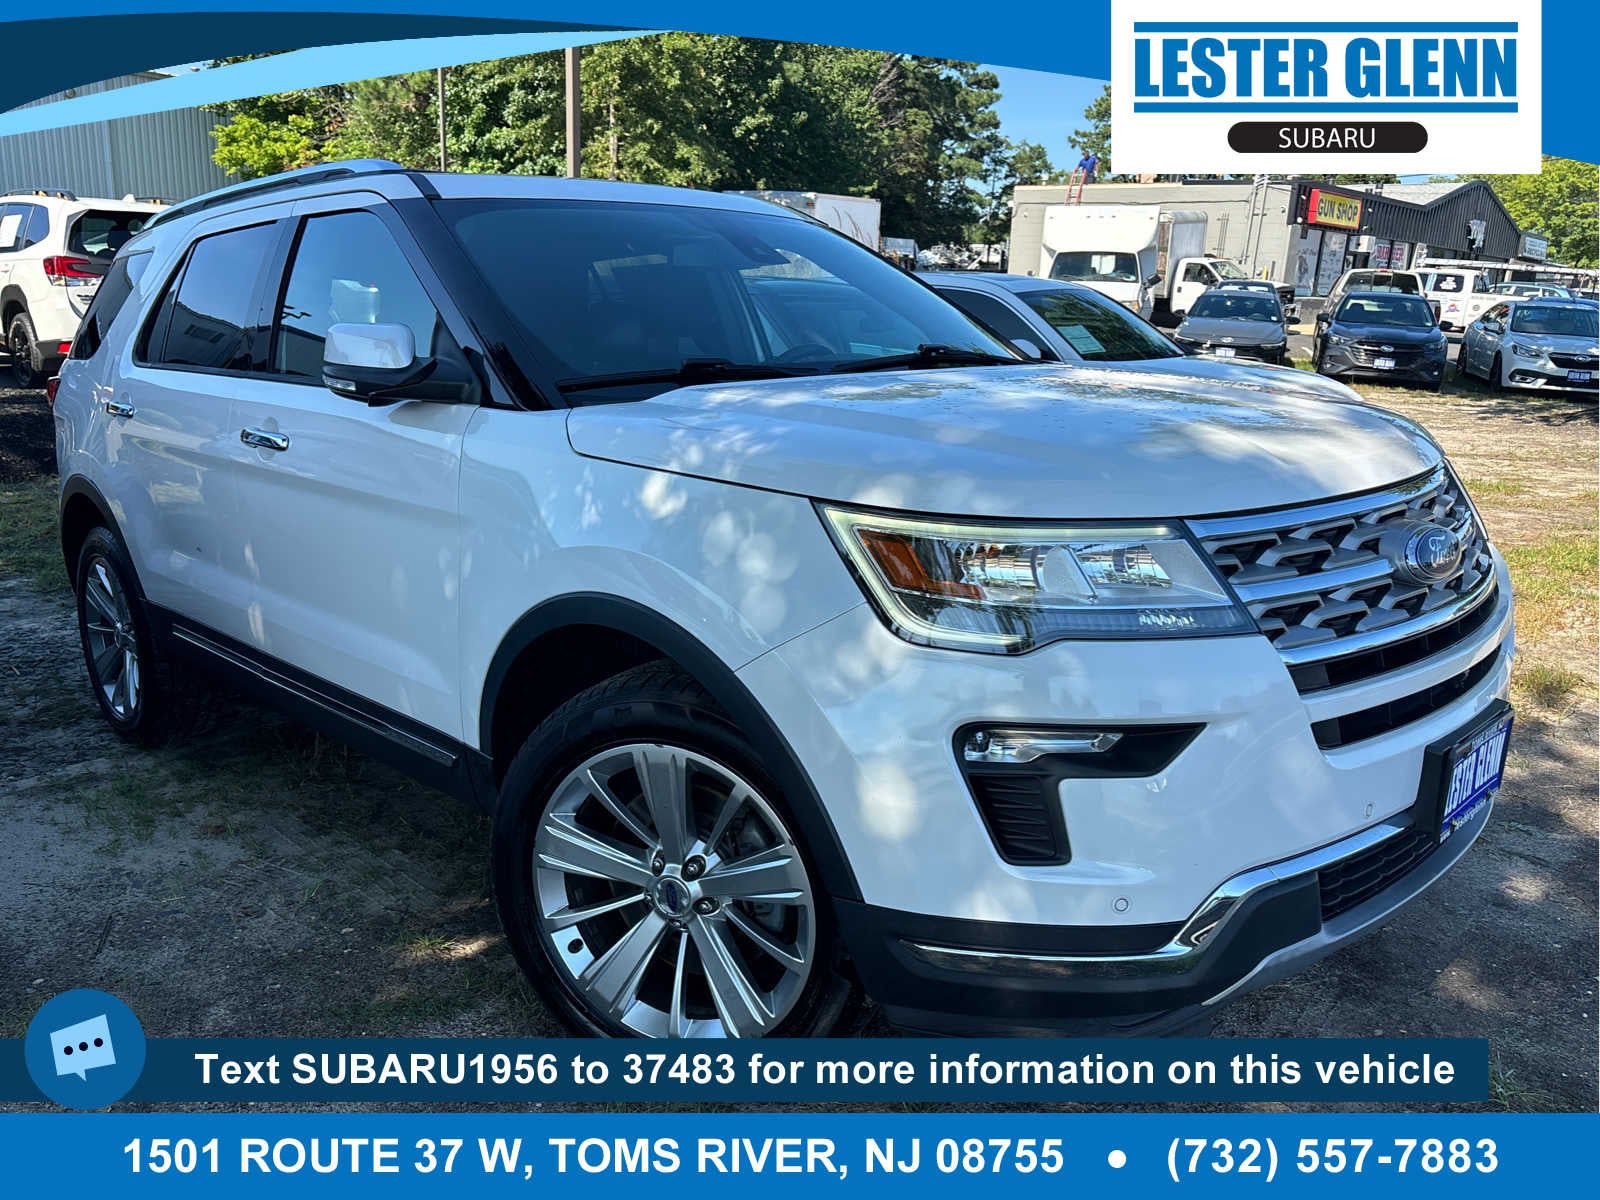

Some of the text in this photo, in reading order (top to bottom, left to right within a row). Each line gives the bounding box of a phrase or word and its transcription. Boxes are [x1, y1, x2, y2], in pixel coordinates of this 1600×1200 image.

[1318, 198, 1359, 221] GUN SHOP
[1474, 731, 1506, 790] GLENN
